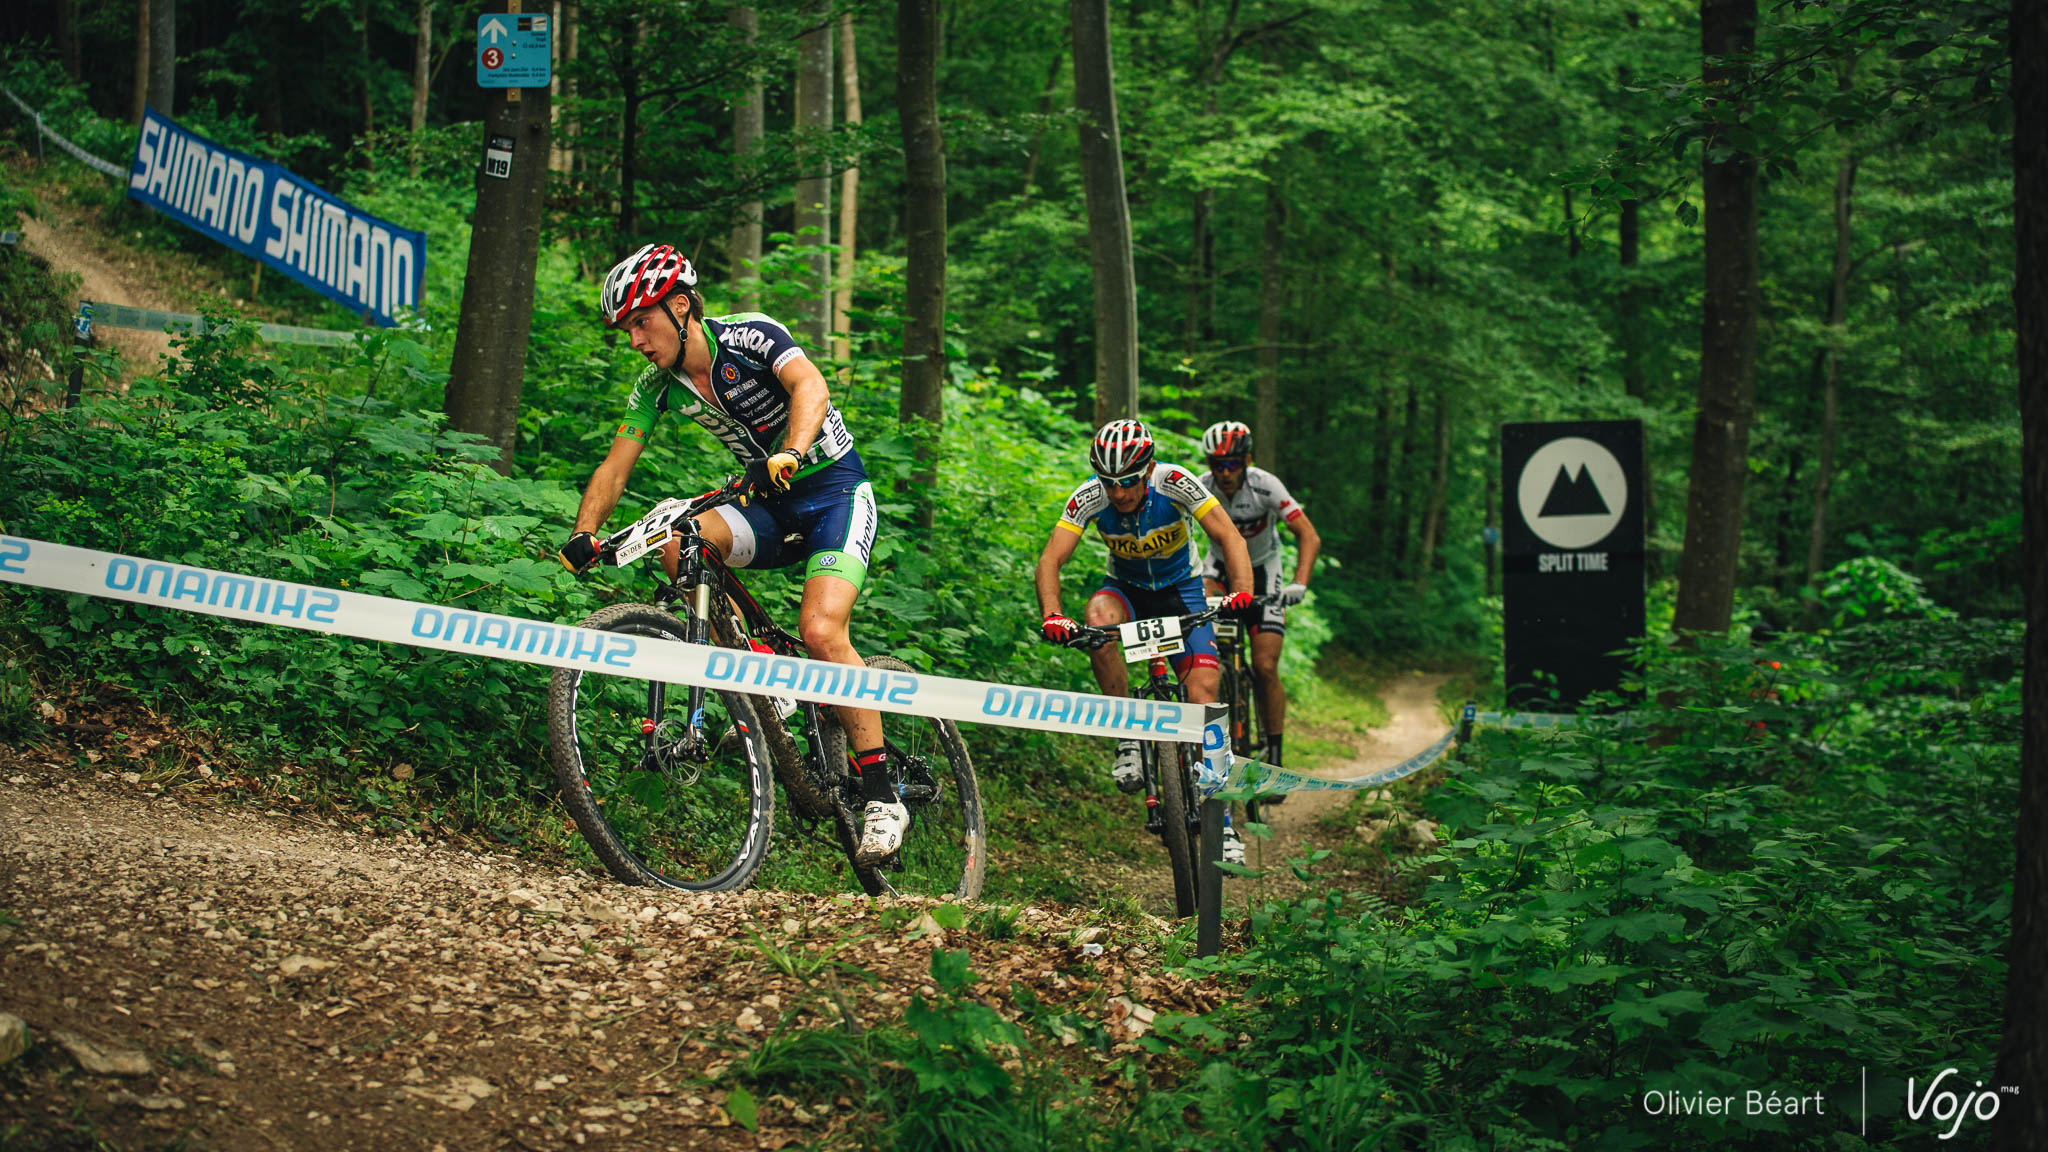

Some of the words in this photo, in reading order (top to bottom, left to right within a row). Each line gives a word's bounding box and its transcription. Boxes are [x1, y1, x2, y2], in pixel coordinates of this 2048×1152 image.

[487, 49, 499, 67] 3
[487, 157, 509, 176] M19
[131, 116, 264, 244] SHIMANO
[265, 177, 413, 321] SHIMANO
[1105, 529, 1182, 554] UKRAINE
[1538, 553, 1575, 572] SPLIT
[1576, 552, 1608, 571] TIME
[1136, 618, 1166, 642] 63
